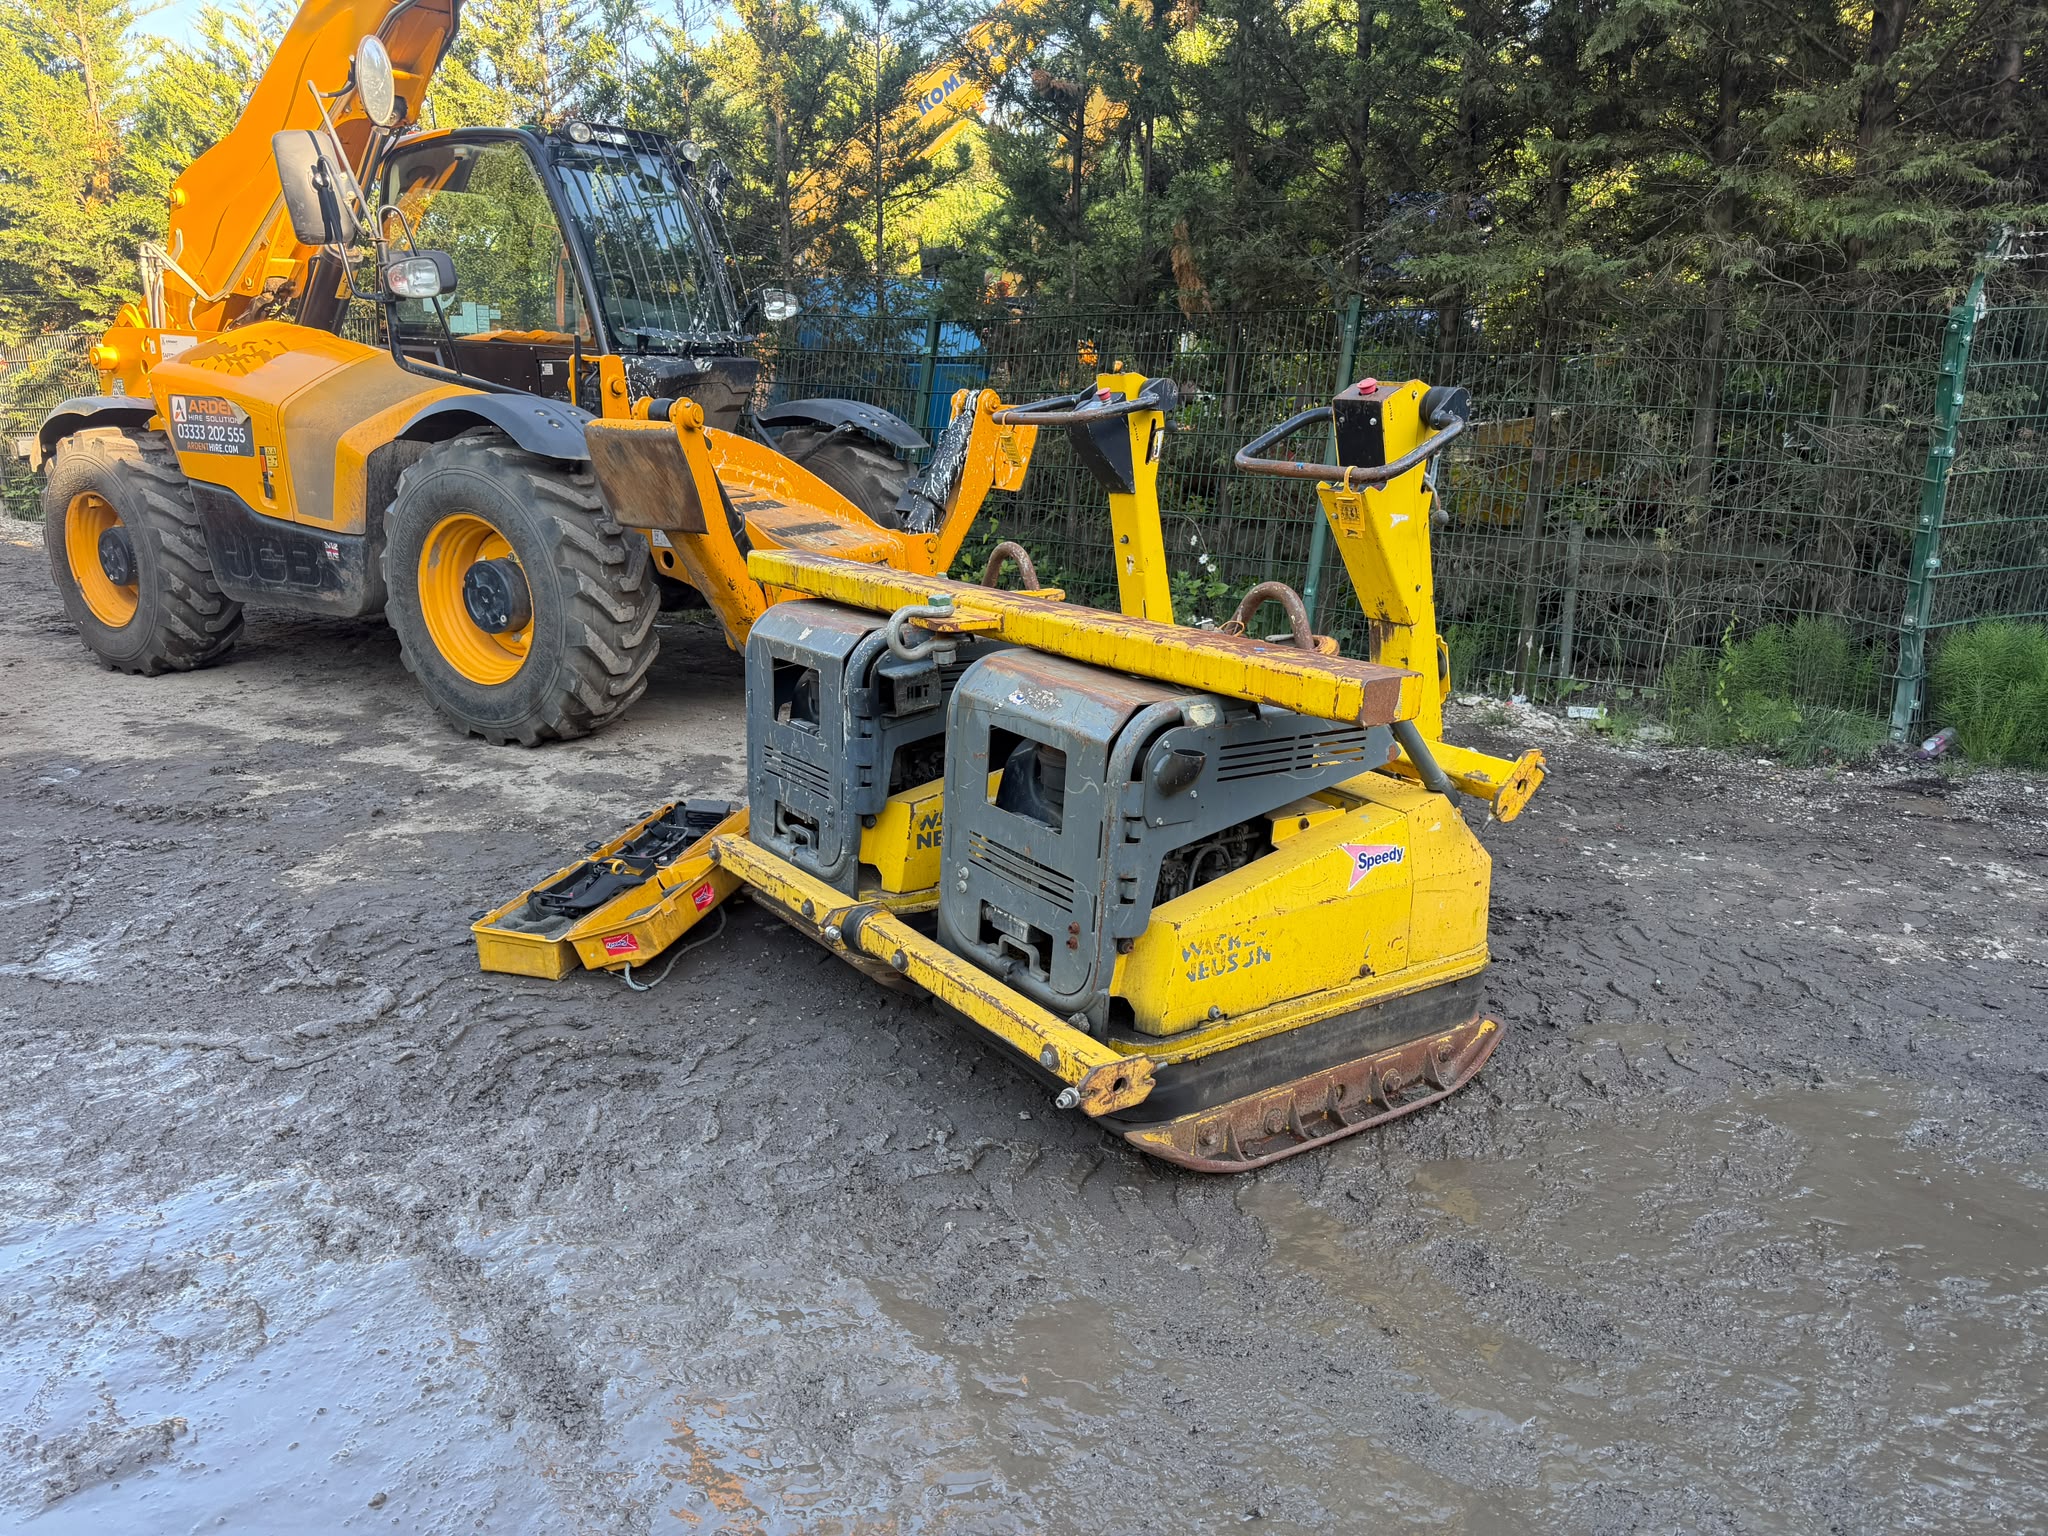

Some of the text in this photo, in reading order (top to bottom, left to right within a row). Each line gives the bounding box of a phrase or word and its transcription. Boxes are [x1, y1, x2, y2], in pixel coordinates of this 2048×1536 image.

[917, 73, 962, 116] KOM
[189, 399, 232, 415] ARDE
[177, 423, 246, 444] 03333 202 555
[187, 441, 238, 453] ARDENTHIRE.COM
[1358, 846, 1404, 871] Speedy
